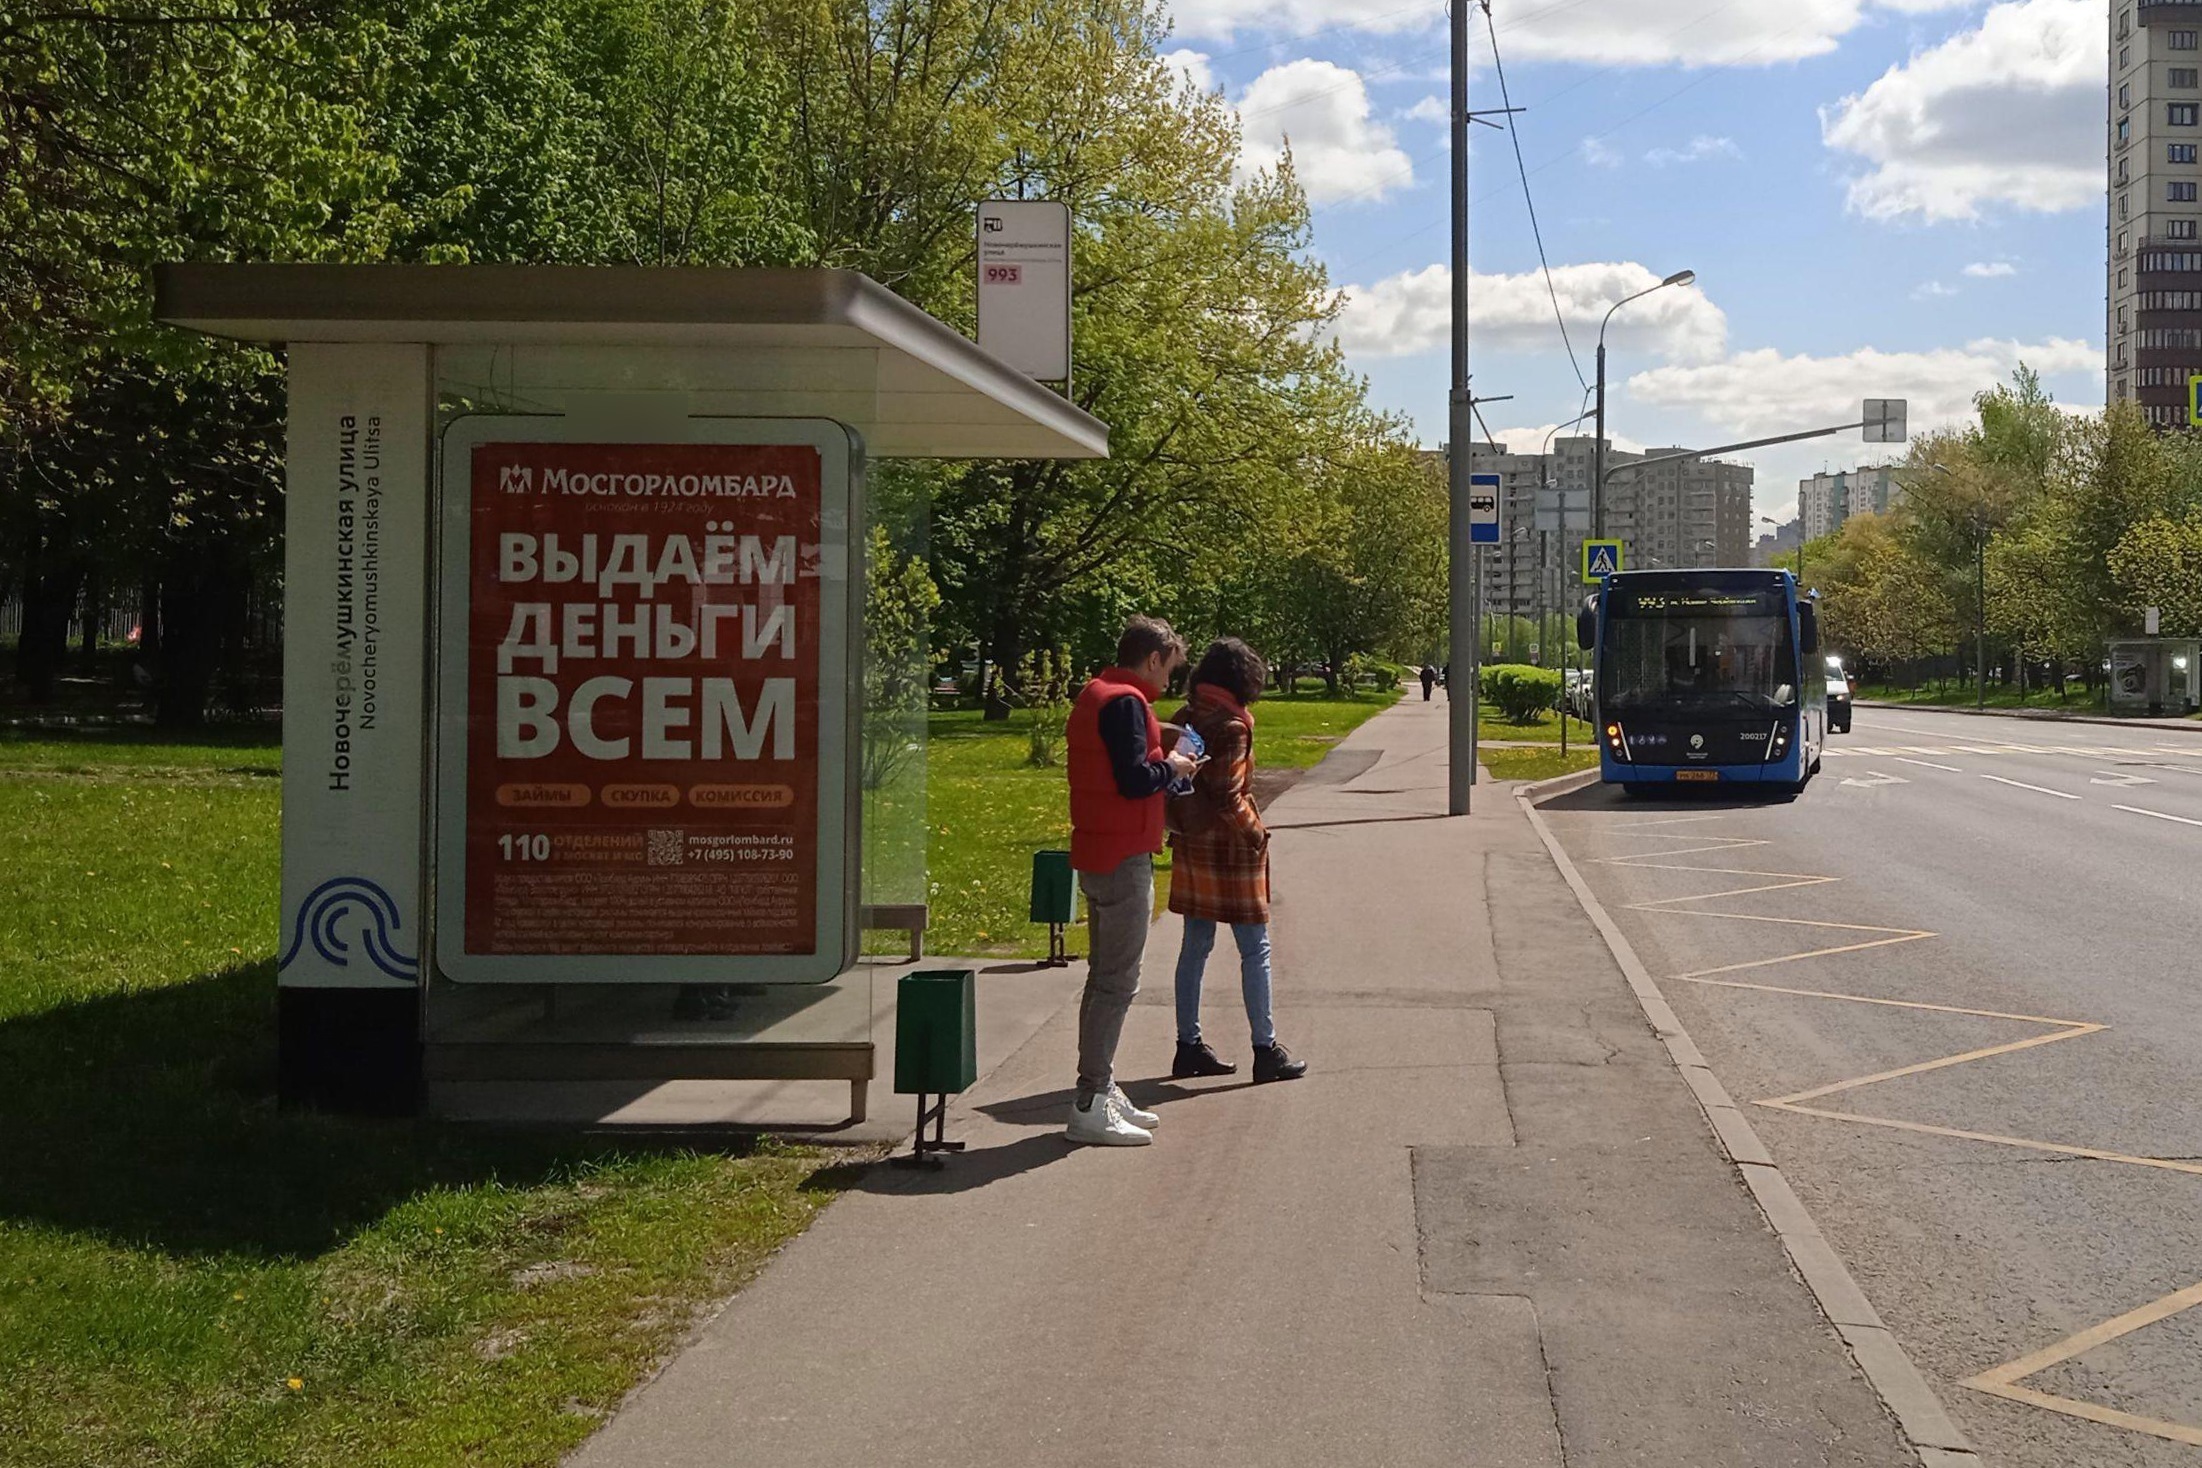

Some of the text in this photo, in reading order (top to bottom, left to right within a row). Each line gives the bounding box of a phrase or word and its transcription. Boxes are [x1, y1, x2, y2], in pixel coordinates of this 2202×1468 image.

[988, 268, 1017, 282] 993
[499, 520, 797, 599] ВЫДАЁМ
[359, 416, 382, 730] Novocheryomushkinskaya Ulitsa
[329, 415, 359, 790] Новочерёмушкинская улица
[497, 603, 796, 675] ДЕНЬГИ
[496, 675, 796, 761] ВСЕМ
[513, 786, 572, 802] ЗАЙМЫ
[610, 789, 671, 802] СКУПКА
[695, 789, 783, 803] КОМИССИЯ
[498, 833, 550, 862] 110
[553, 832, 644, 851] ОТДЕЛЕНИЙ
[688, 834, 794, 848] mosgorlombard.ru
[688, 848, 794, 862] +7 (495) 108-73-90
